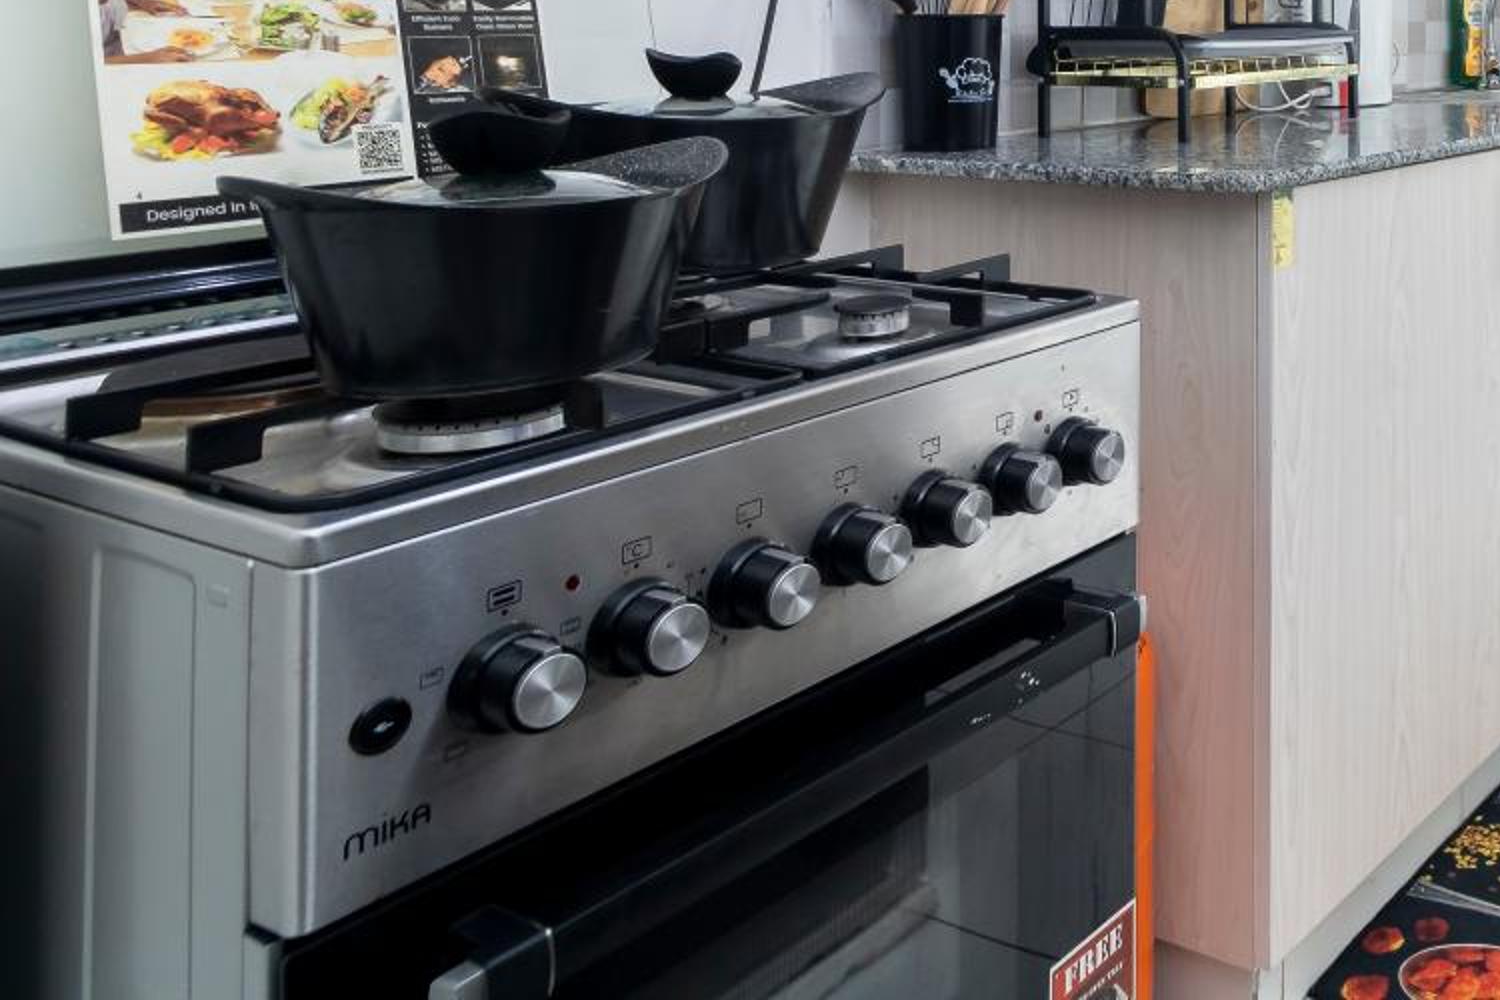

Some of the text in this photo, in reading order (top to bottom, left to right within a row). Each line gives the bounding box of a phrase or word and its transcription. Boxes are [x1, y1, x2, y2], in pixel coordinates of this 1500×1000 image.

[146, 202, 226, 223] Designed
[343, 803, 431, 861] MIKA
[1064, 923, 1123, 994] FREE
